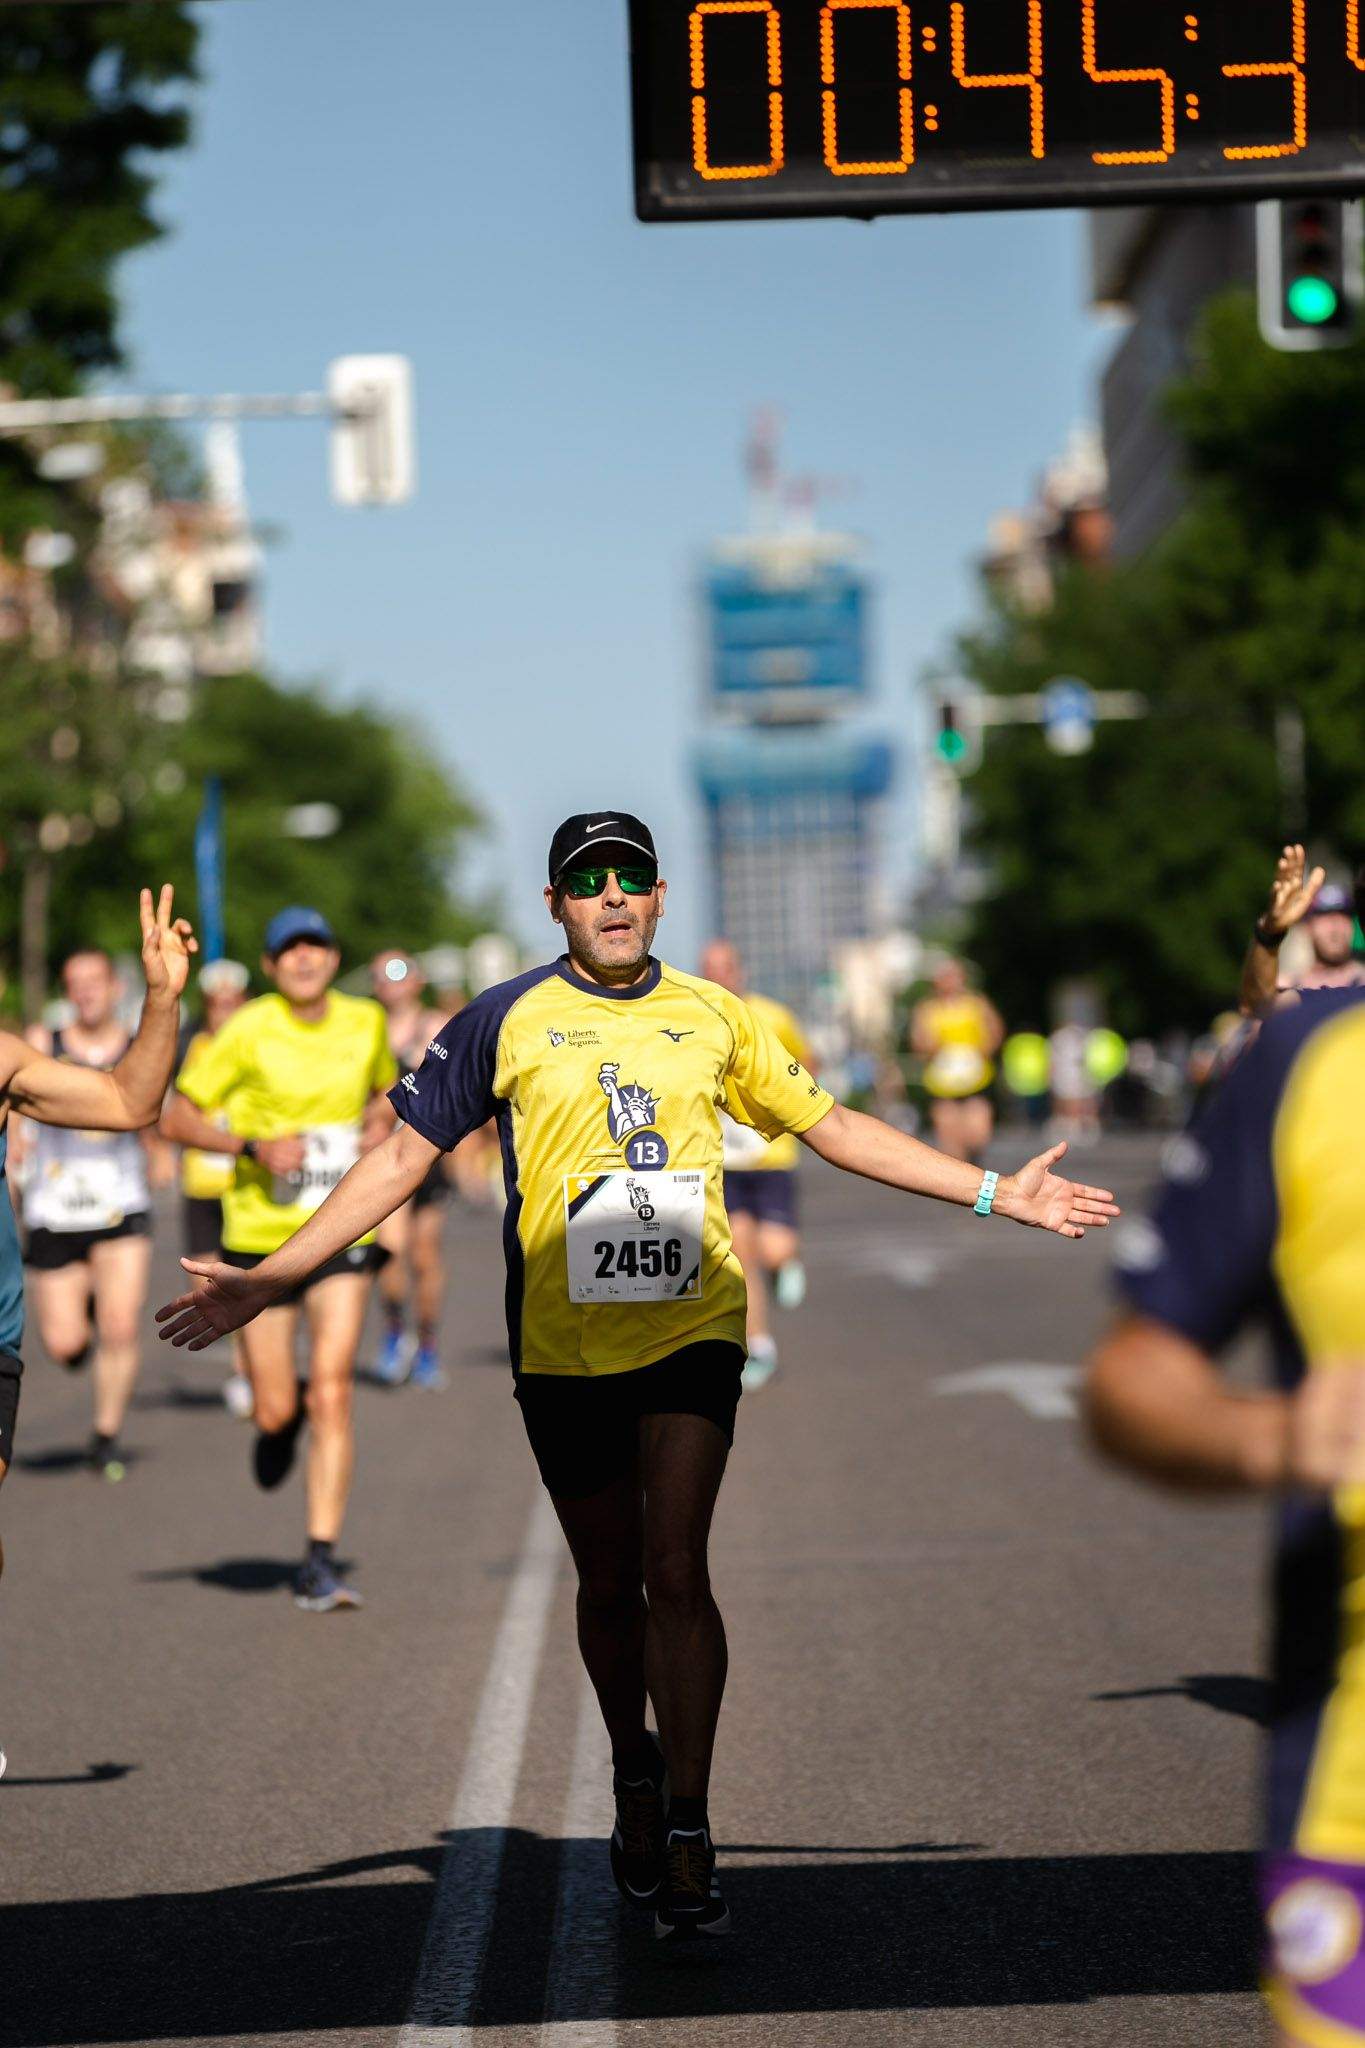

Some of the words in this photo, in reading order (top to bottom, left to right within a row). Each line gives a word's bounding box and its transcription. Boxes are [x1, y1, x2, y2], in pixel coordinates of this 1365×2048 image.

[690, 0, 1365, 180] 00:45:3
[567, 1029, 599, 1039] Liberty
[568, 1039, 602, 1048] Seguros
[633, 1141, 661, 1164] 13
[640, 1207, 652, 1218] 13
[593, 1238, 682, 1279] 2456
